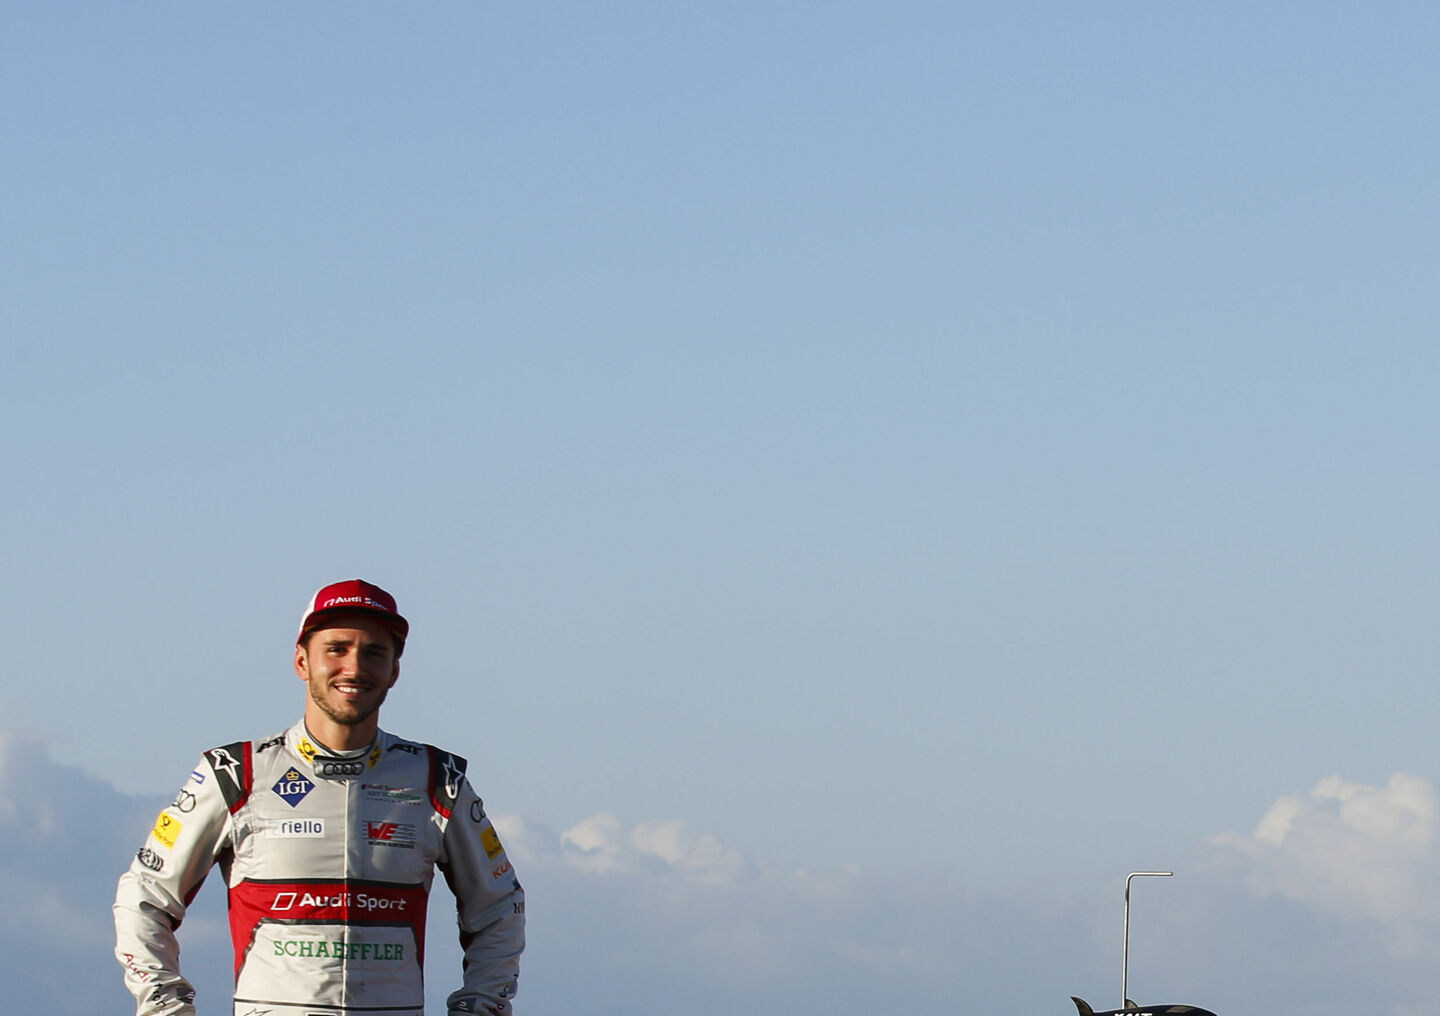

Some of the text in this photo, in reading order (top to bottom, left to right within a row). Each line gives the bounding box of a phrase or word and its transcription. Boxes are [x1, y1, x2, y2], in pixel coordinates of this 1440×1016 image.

[335, 596, 362, 605] Audi
[278, 780, 310, 796] LGT
[281, 820, 323, 835] riello
[299, 892, 407, 912] Audi Sport
[273, 940, 404, 961] SCHAEFFLER
